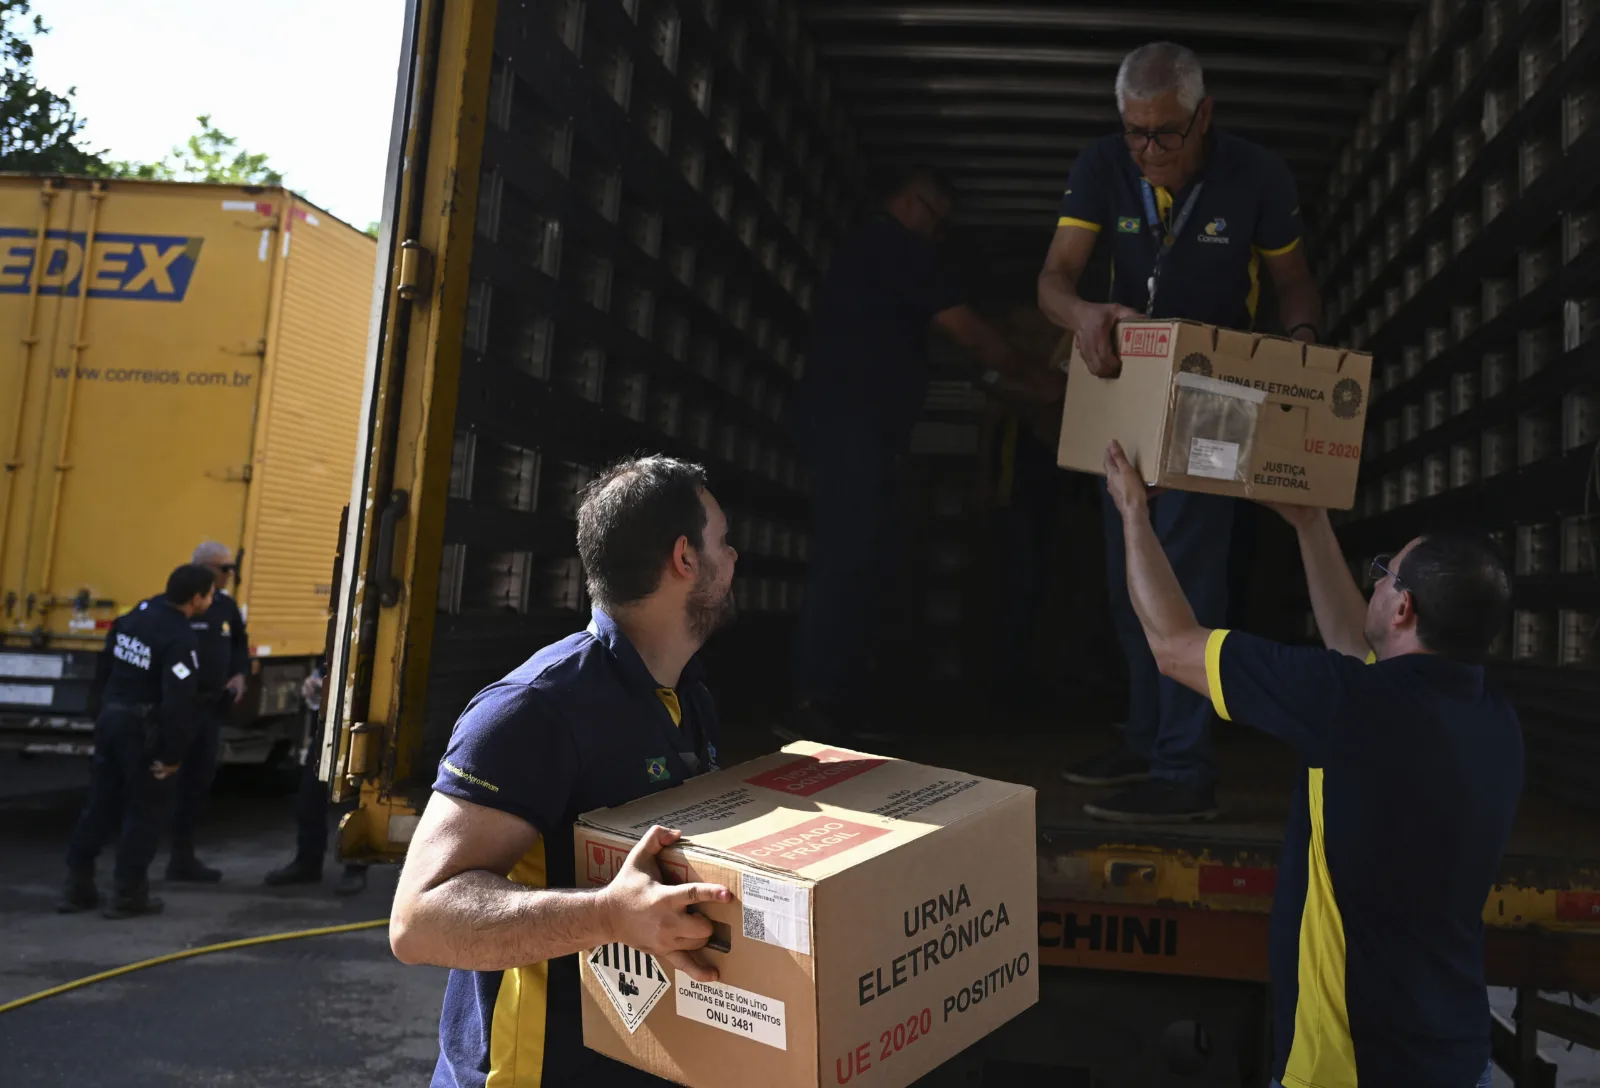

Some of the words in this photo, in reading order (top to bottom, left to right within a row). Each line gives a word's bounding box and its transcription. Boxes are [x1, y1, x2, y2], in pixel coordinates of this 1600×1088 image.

[1253, 380, 1325, 402] ELETRÔNICA
[1304, 438, 1325, 455] UE
[1328, 442, 1360, 460] 2020
[1254, 474, 1311, 490] ELEITORAL
[1262, 461, 1306, 477] JUSTIÇA
[751, 822, 845, 857] CUIDADO
[779, 831, 861, 860] FRÁGIL
[903, 883, 972, 938] URNA
[858, 902, 1010, 1007] ELETRÔNICA
[690, 980, 724, 998] BATERIAS
[724, 991, 735, 1001] DE
[750, 999, 768, 1012] LÍTIO
[943, 951, 1030, 1023] POSITIVO
[627, 1002, 633, 1012] 9
[678, 987, 713, 1005] CONTIDAS
[714, 998, 725, 1008] EM
[726, 1003, 781, 1026] EQUIPAMENTOS
[706, 1008, 729, 1025] ONU
[731, 1016, 754, 1033] 3481
[835, 1041, 872, 1085] UE
[879, 1007, 932, 1062] 2020
